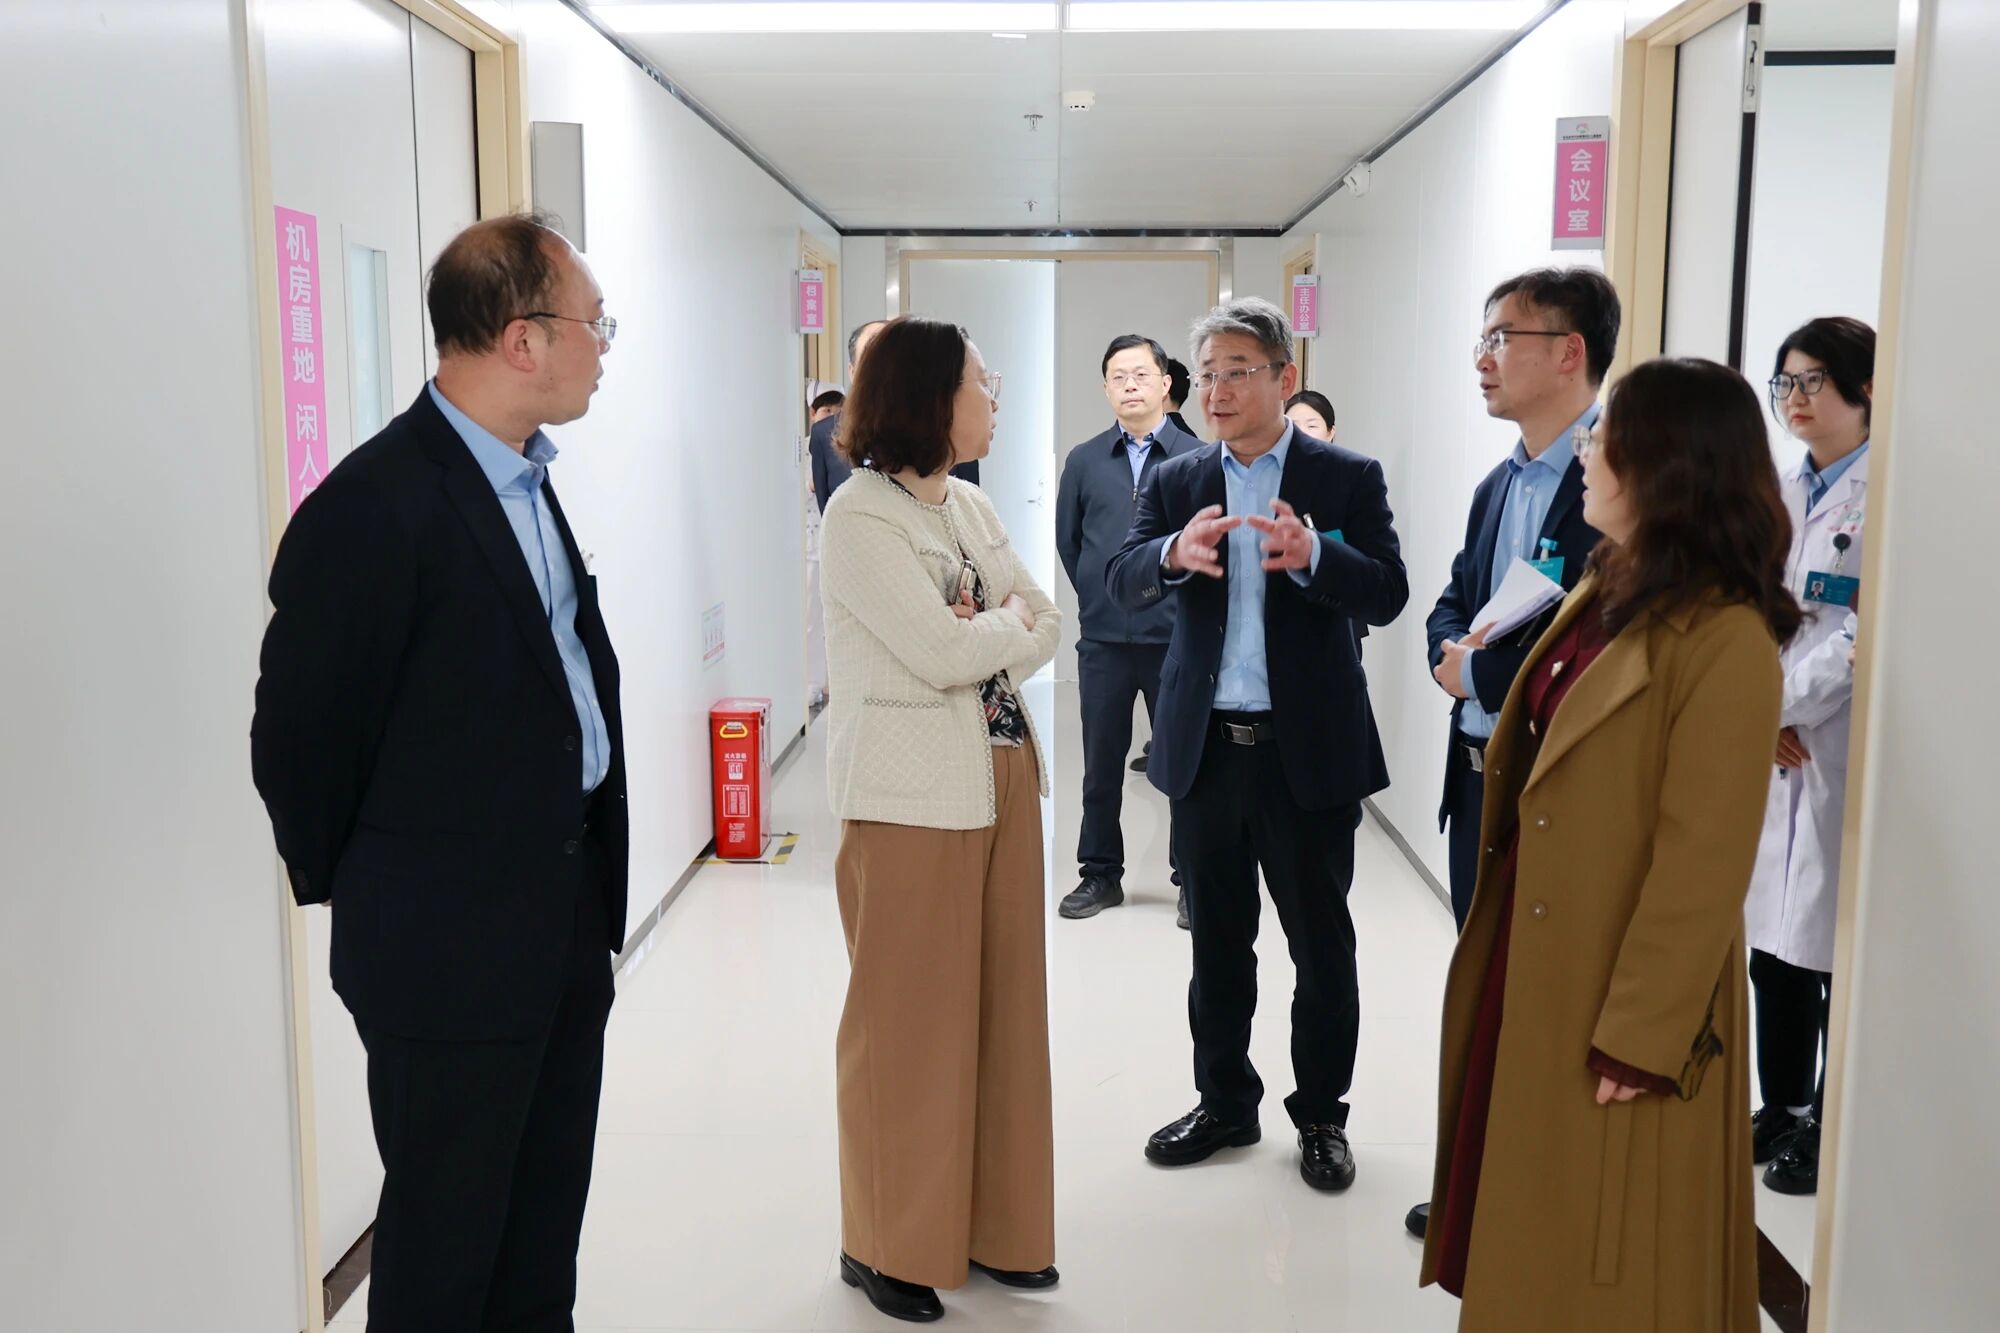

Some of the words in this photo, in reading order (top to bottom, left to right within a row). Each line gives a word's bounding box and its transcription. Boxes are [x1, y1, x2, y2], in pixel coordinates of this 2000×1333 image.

[1567, 147, 1593, 232] 会议室
[285, 220, 316, 383] 机房重地
[1299, 287, 1310, 331] 主任办公室
